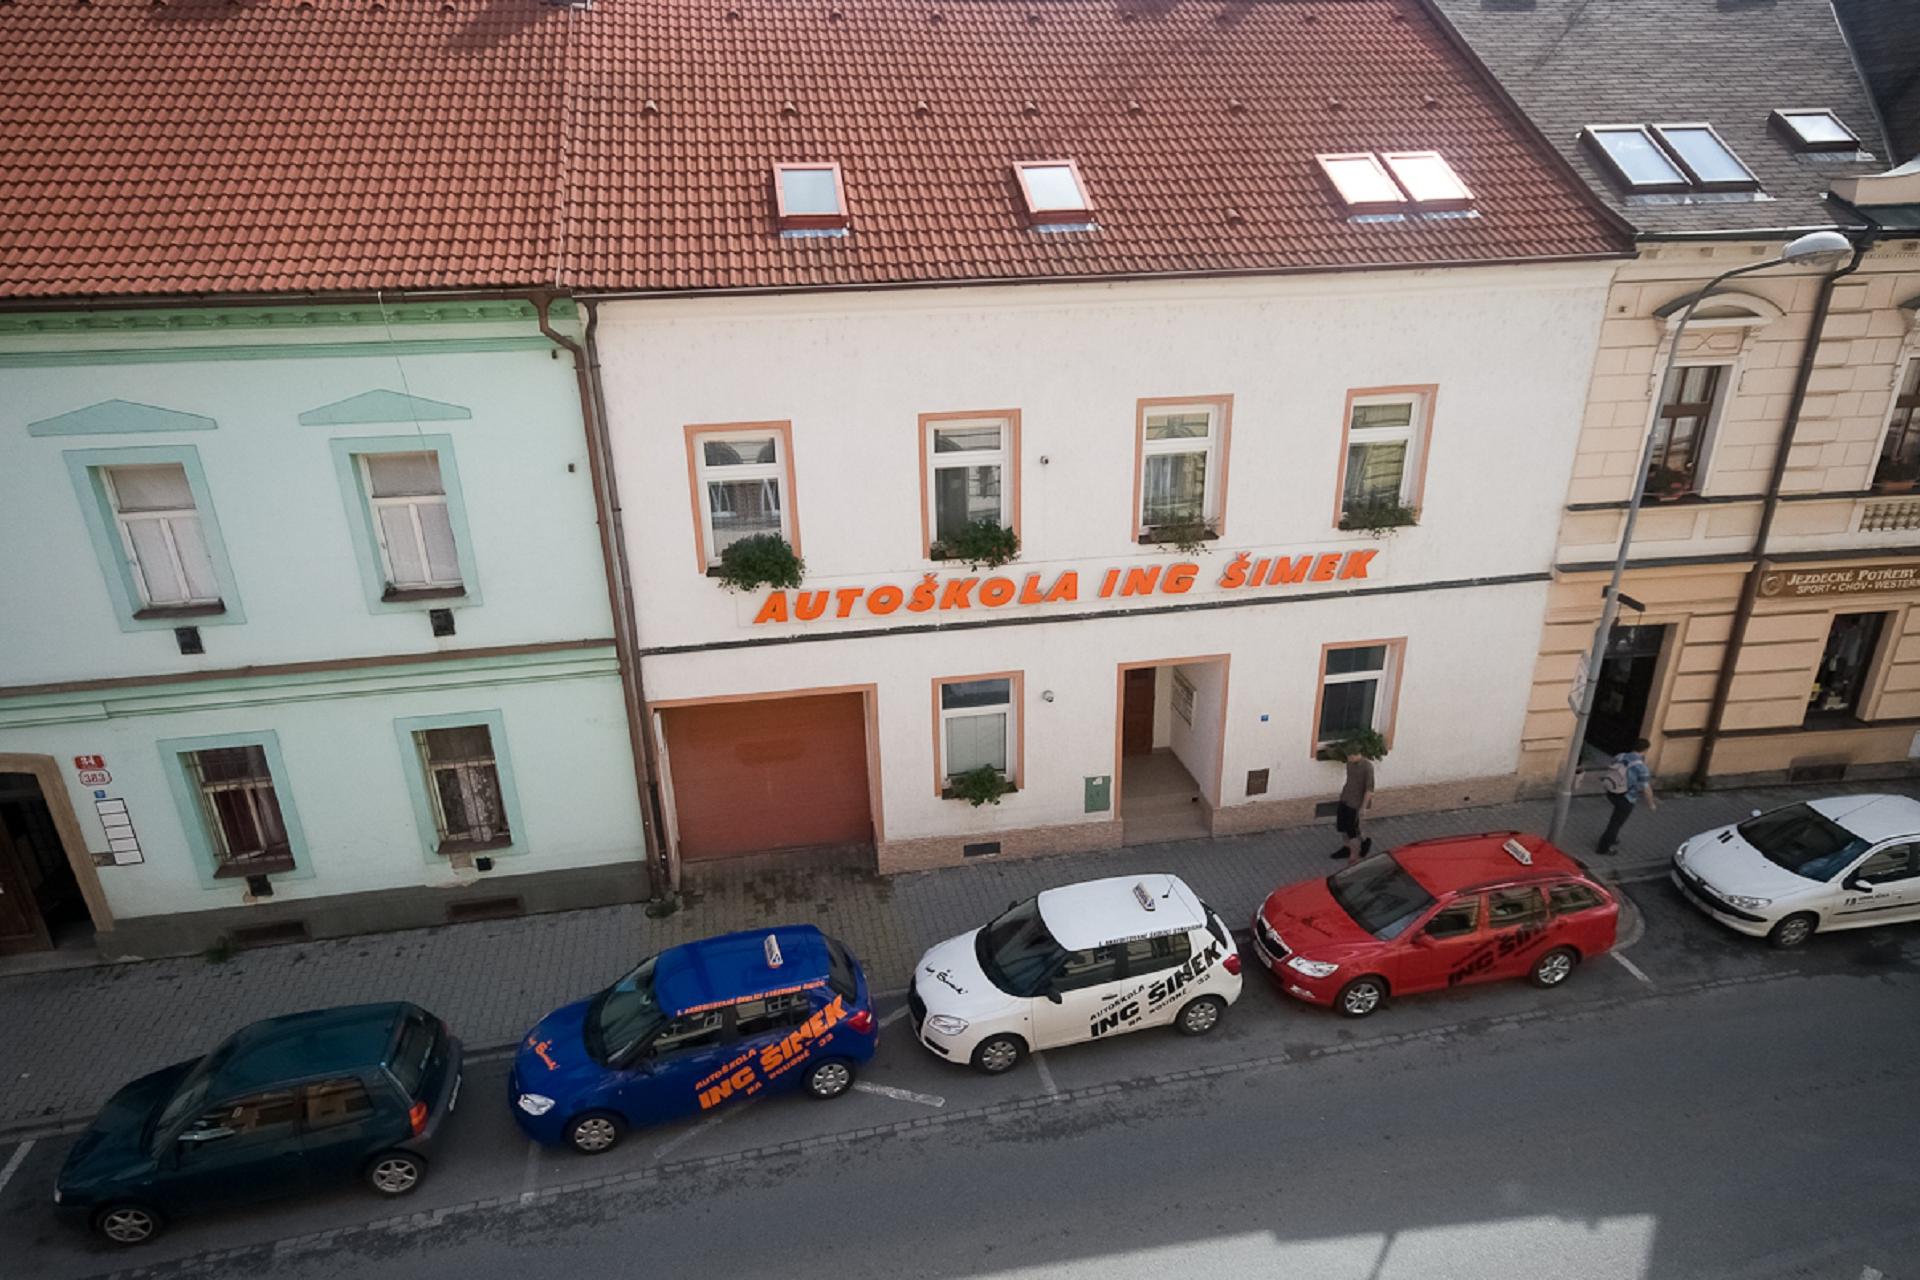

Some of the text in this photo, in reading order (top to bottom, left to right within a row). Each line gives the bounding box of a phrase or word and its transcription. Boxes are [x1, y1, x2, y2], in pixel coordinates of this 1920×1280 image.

[753, 549, 1379, 624] AUTOŠKOLA ING ŠIMEK
[1796, 584, 1831, 595] SPORT
[1090, 1001, 1140, 1037] ING
[1148, 940, 1221, 1006] ŠIMEK
[1090, 984, 1145, 1020] AUTOŠKOLA
[695, 1048, 756, 1090] AUTOŠKOLA
[698, 1066, 755, 1110] ING
[759, 994, 848, 1073] ŠIMEK
